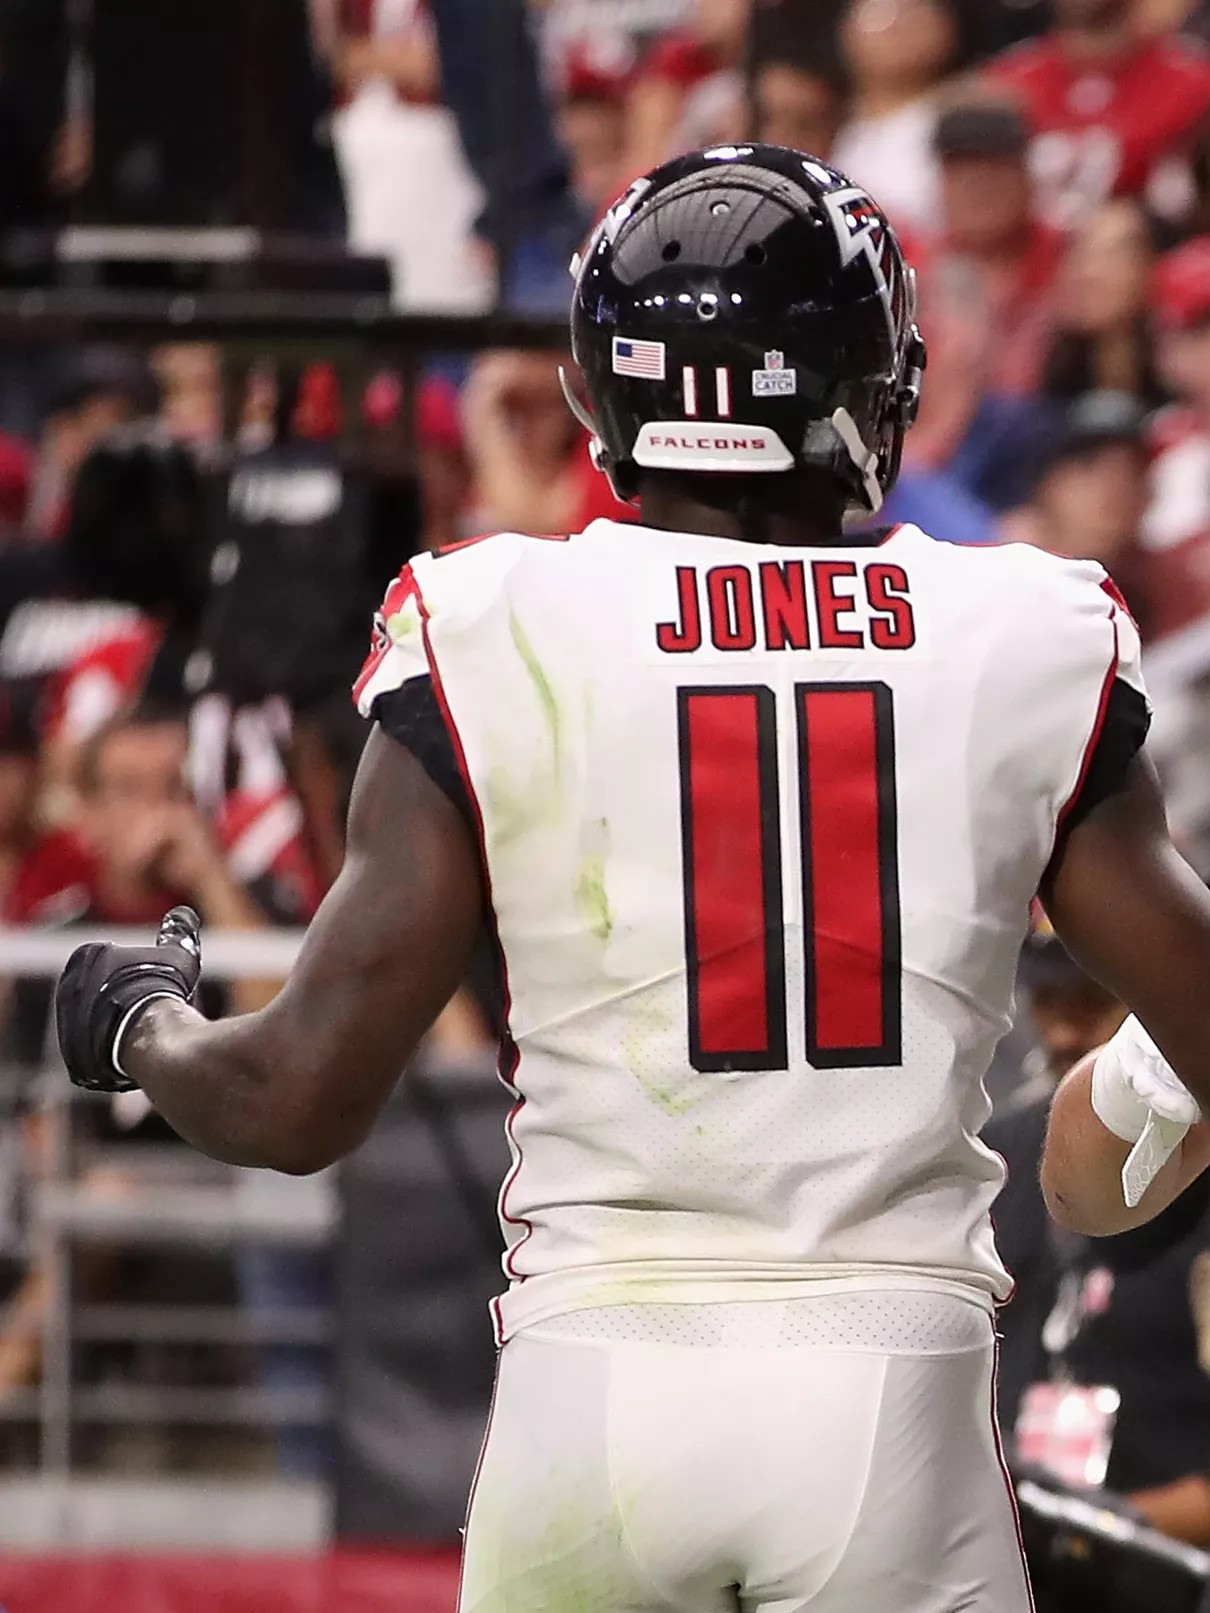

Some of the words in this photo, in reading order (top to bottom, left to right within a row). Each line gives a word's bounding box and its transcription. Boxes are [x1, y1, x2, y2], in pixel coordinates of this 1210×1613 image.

[683, 366, 730, 417] 11
[755, 380, 793, 391] CATCH
[650, 436, 766, 450] FALCONS
[655, 560, 916, 653] JONES
[676, 680, 903, 1072] 11
